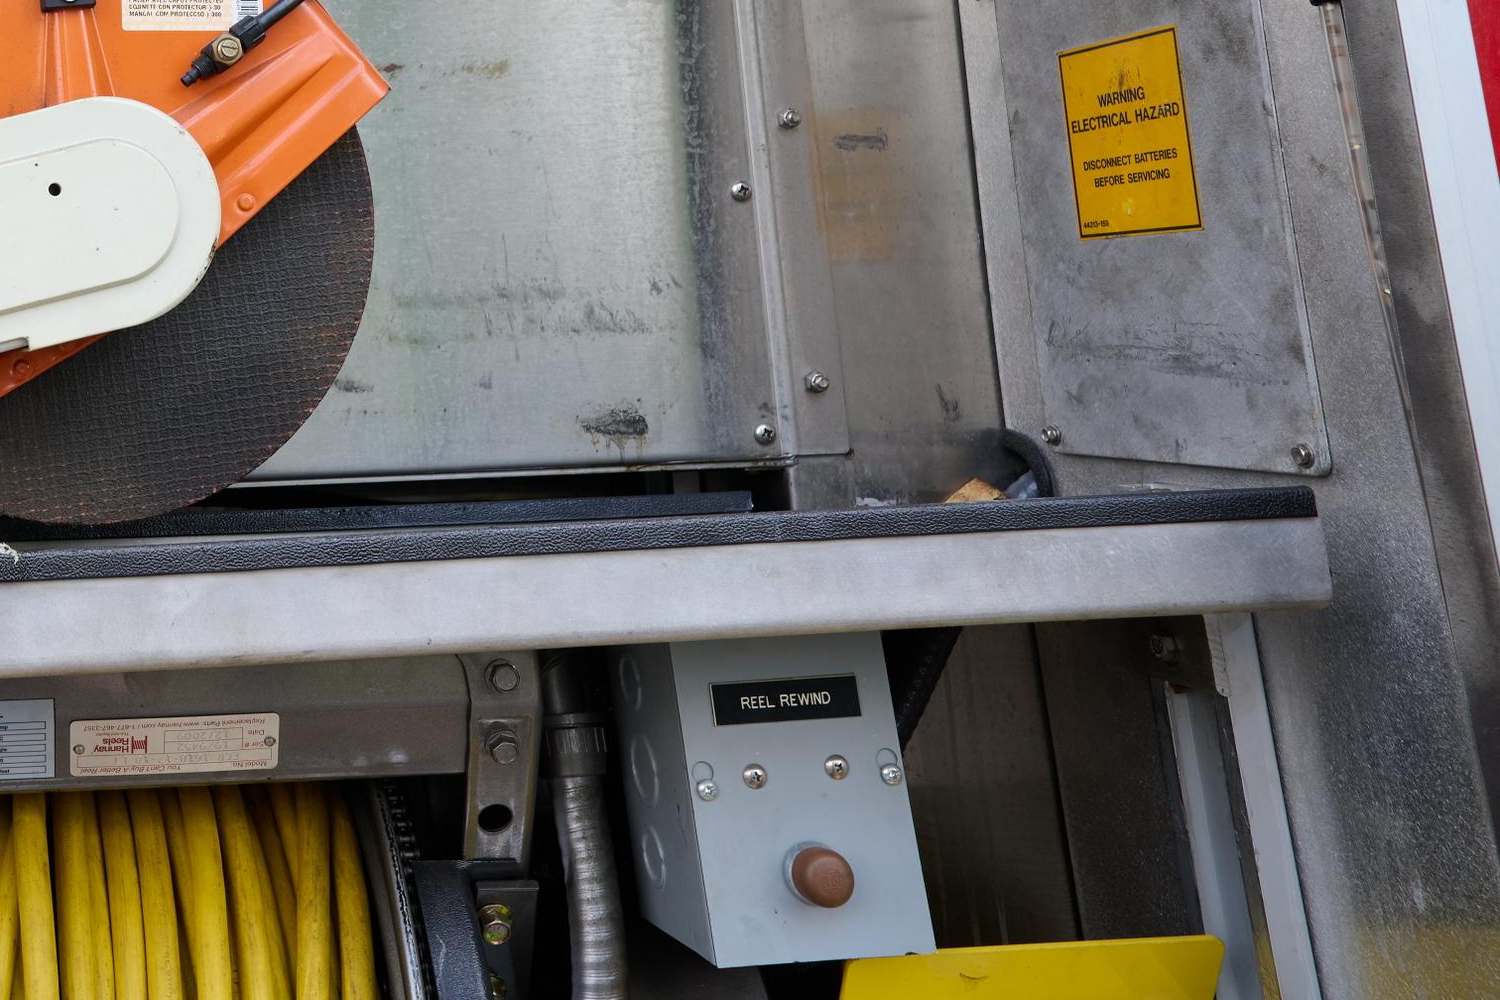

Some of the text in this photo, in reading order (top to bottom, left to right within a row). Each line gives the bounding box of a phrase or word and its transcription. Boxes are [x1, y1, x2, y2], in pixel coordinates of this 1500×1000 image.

[1097, 86, 1145, 107] WARNING
[1071, 102, 1180, 133] ELECTRICAL HAZARD
[1083, 148, 1178, 171] DISCONNECT BATTERIES
[1094, 168, 1170, 188] BEFORE SERVICING
[740, 691, 831, 710] REEL REWIND
[141, 721, 200, 729] www.hannay.com
[93, 745, 129, 753] Hannay
[102, 737, 129, 745] Reels
